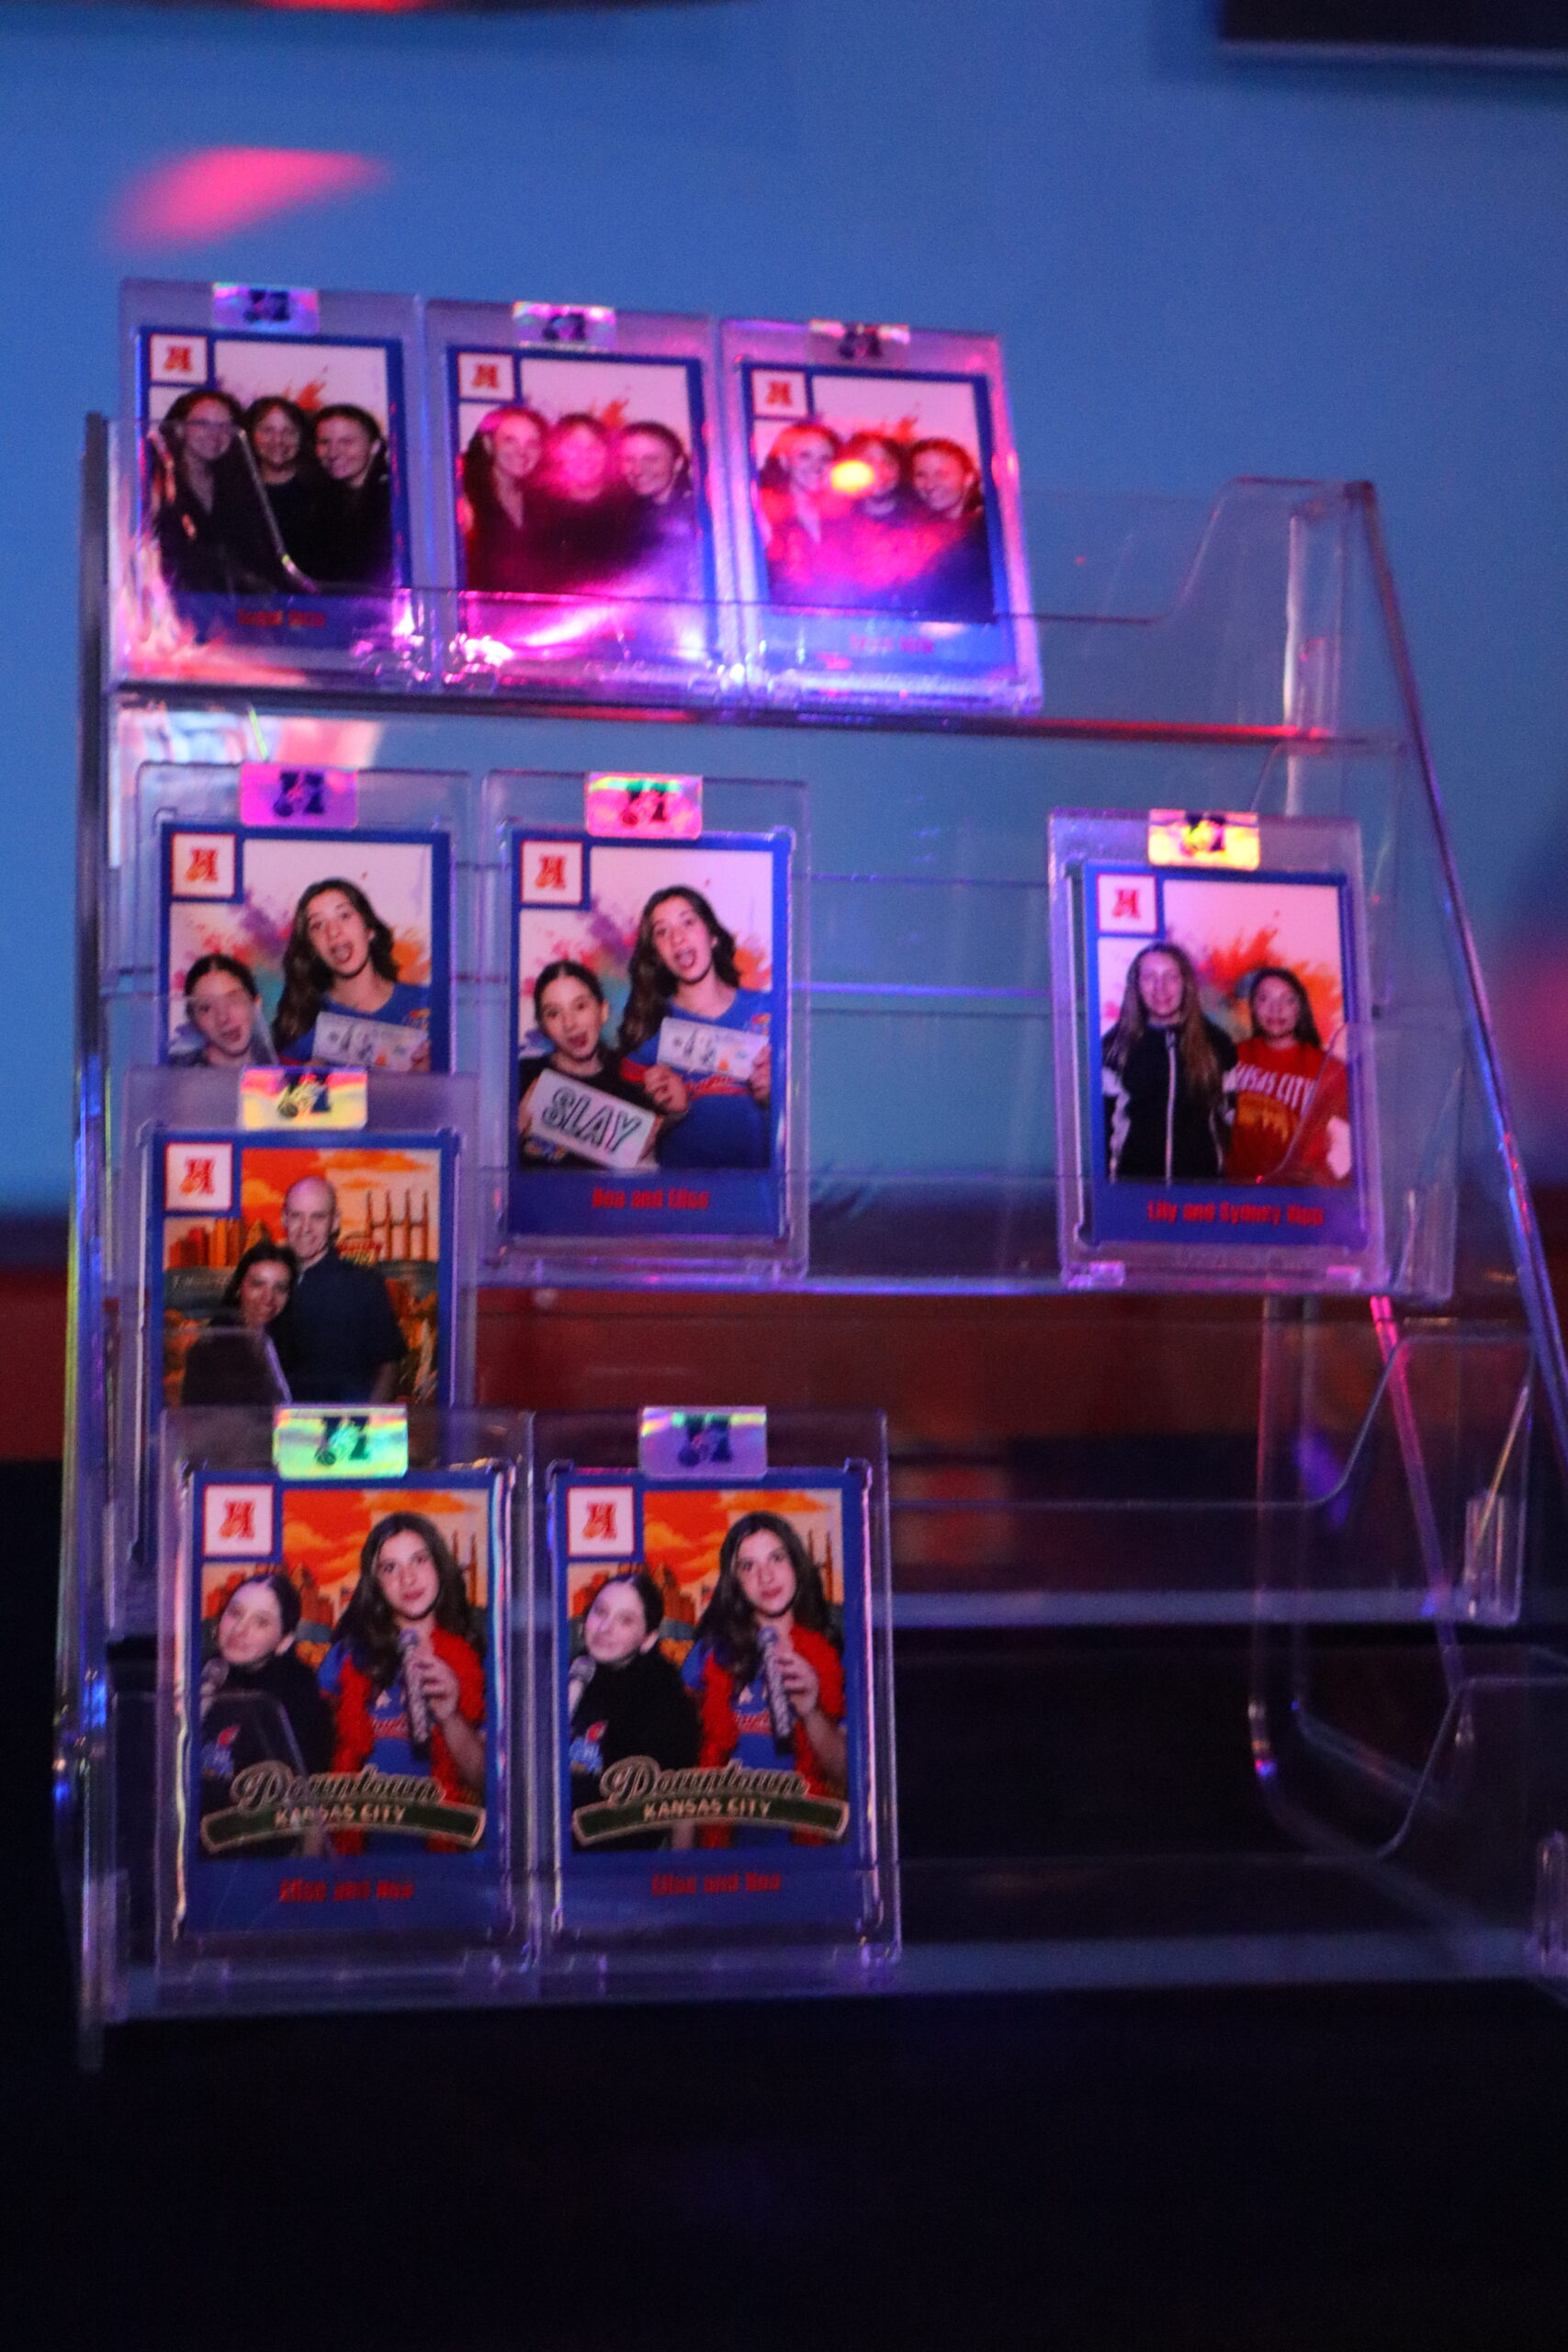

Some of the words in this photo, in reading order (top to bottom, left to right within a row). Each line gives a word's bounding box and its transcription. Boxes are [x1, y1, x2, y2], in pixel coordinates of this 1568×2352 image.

[540, 1086, 643, 1153] SLAY
[231, 1759, 445, 1815] Downtown
[600, 1755, 809, 1807] Downtown
[643, 1797, 722, 1823] KANSAS
[727, 1798, 773, 1817] CITY
